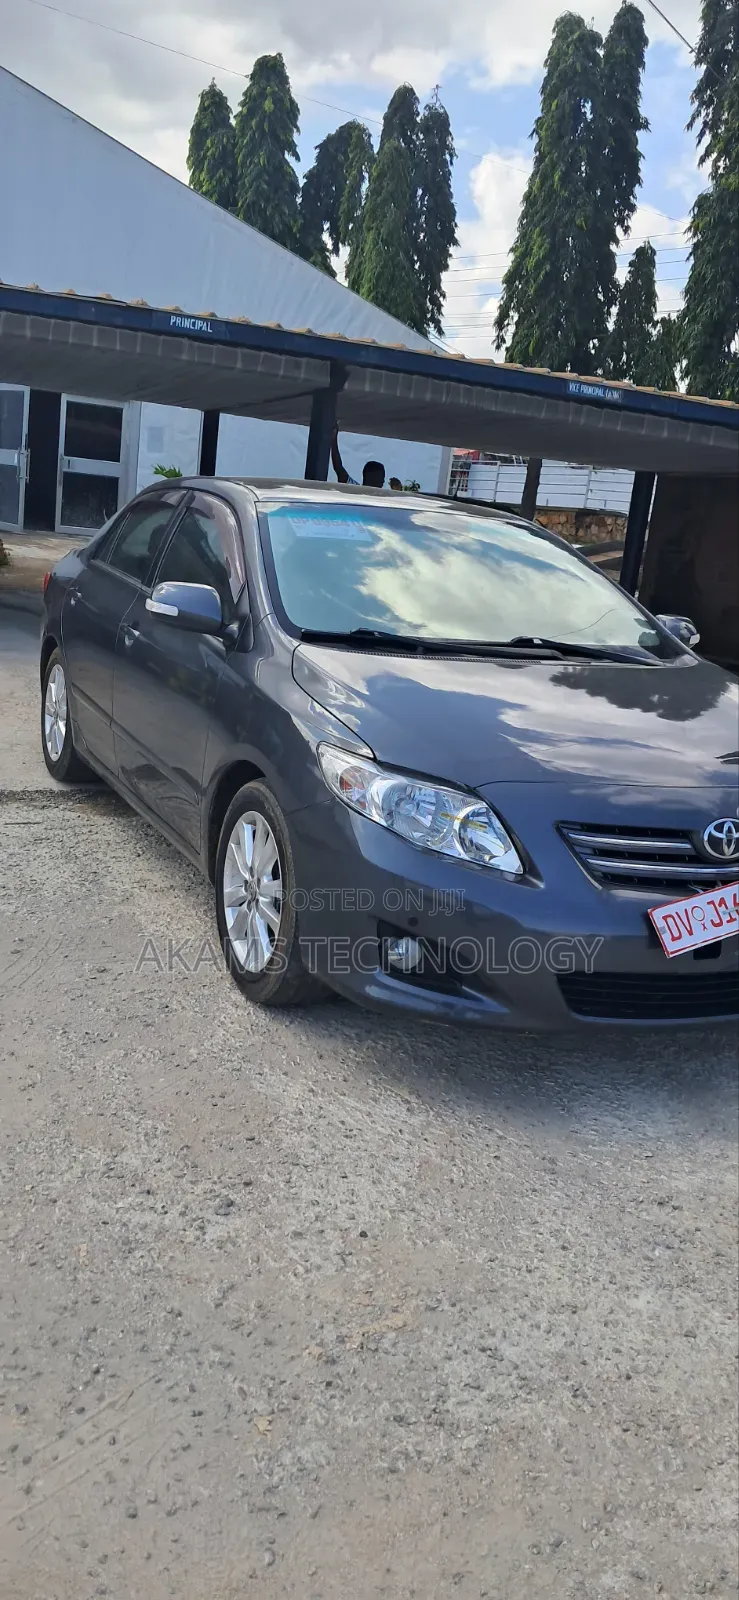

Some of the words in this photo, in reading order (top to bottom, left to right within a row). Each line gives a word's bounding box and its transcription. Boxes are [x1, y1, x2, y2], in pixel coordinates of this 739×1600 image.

[170, 315, 213, 333] PRINCIPAL
[569, 382, 580, 393] VICE
[580, 384, 605, 397] PRINCIPAL
[661, 908, 694, 942] DV
